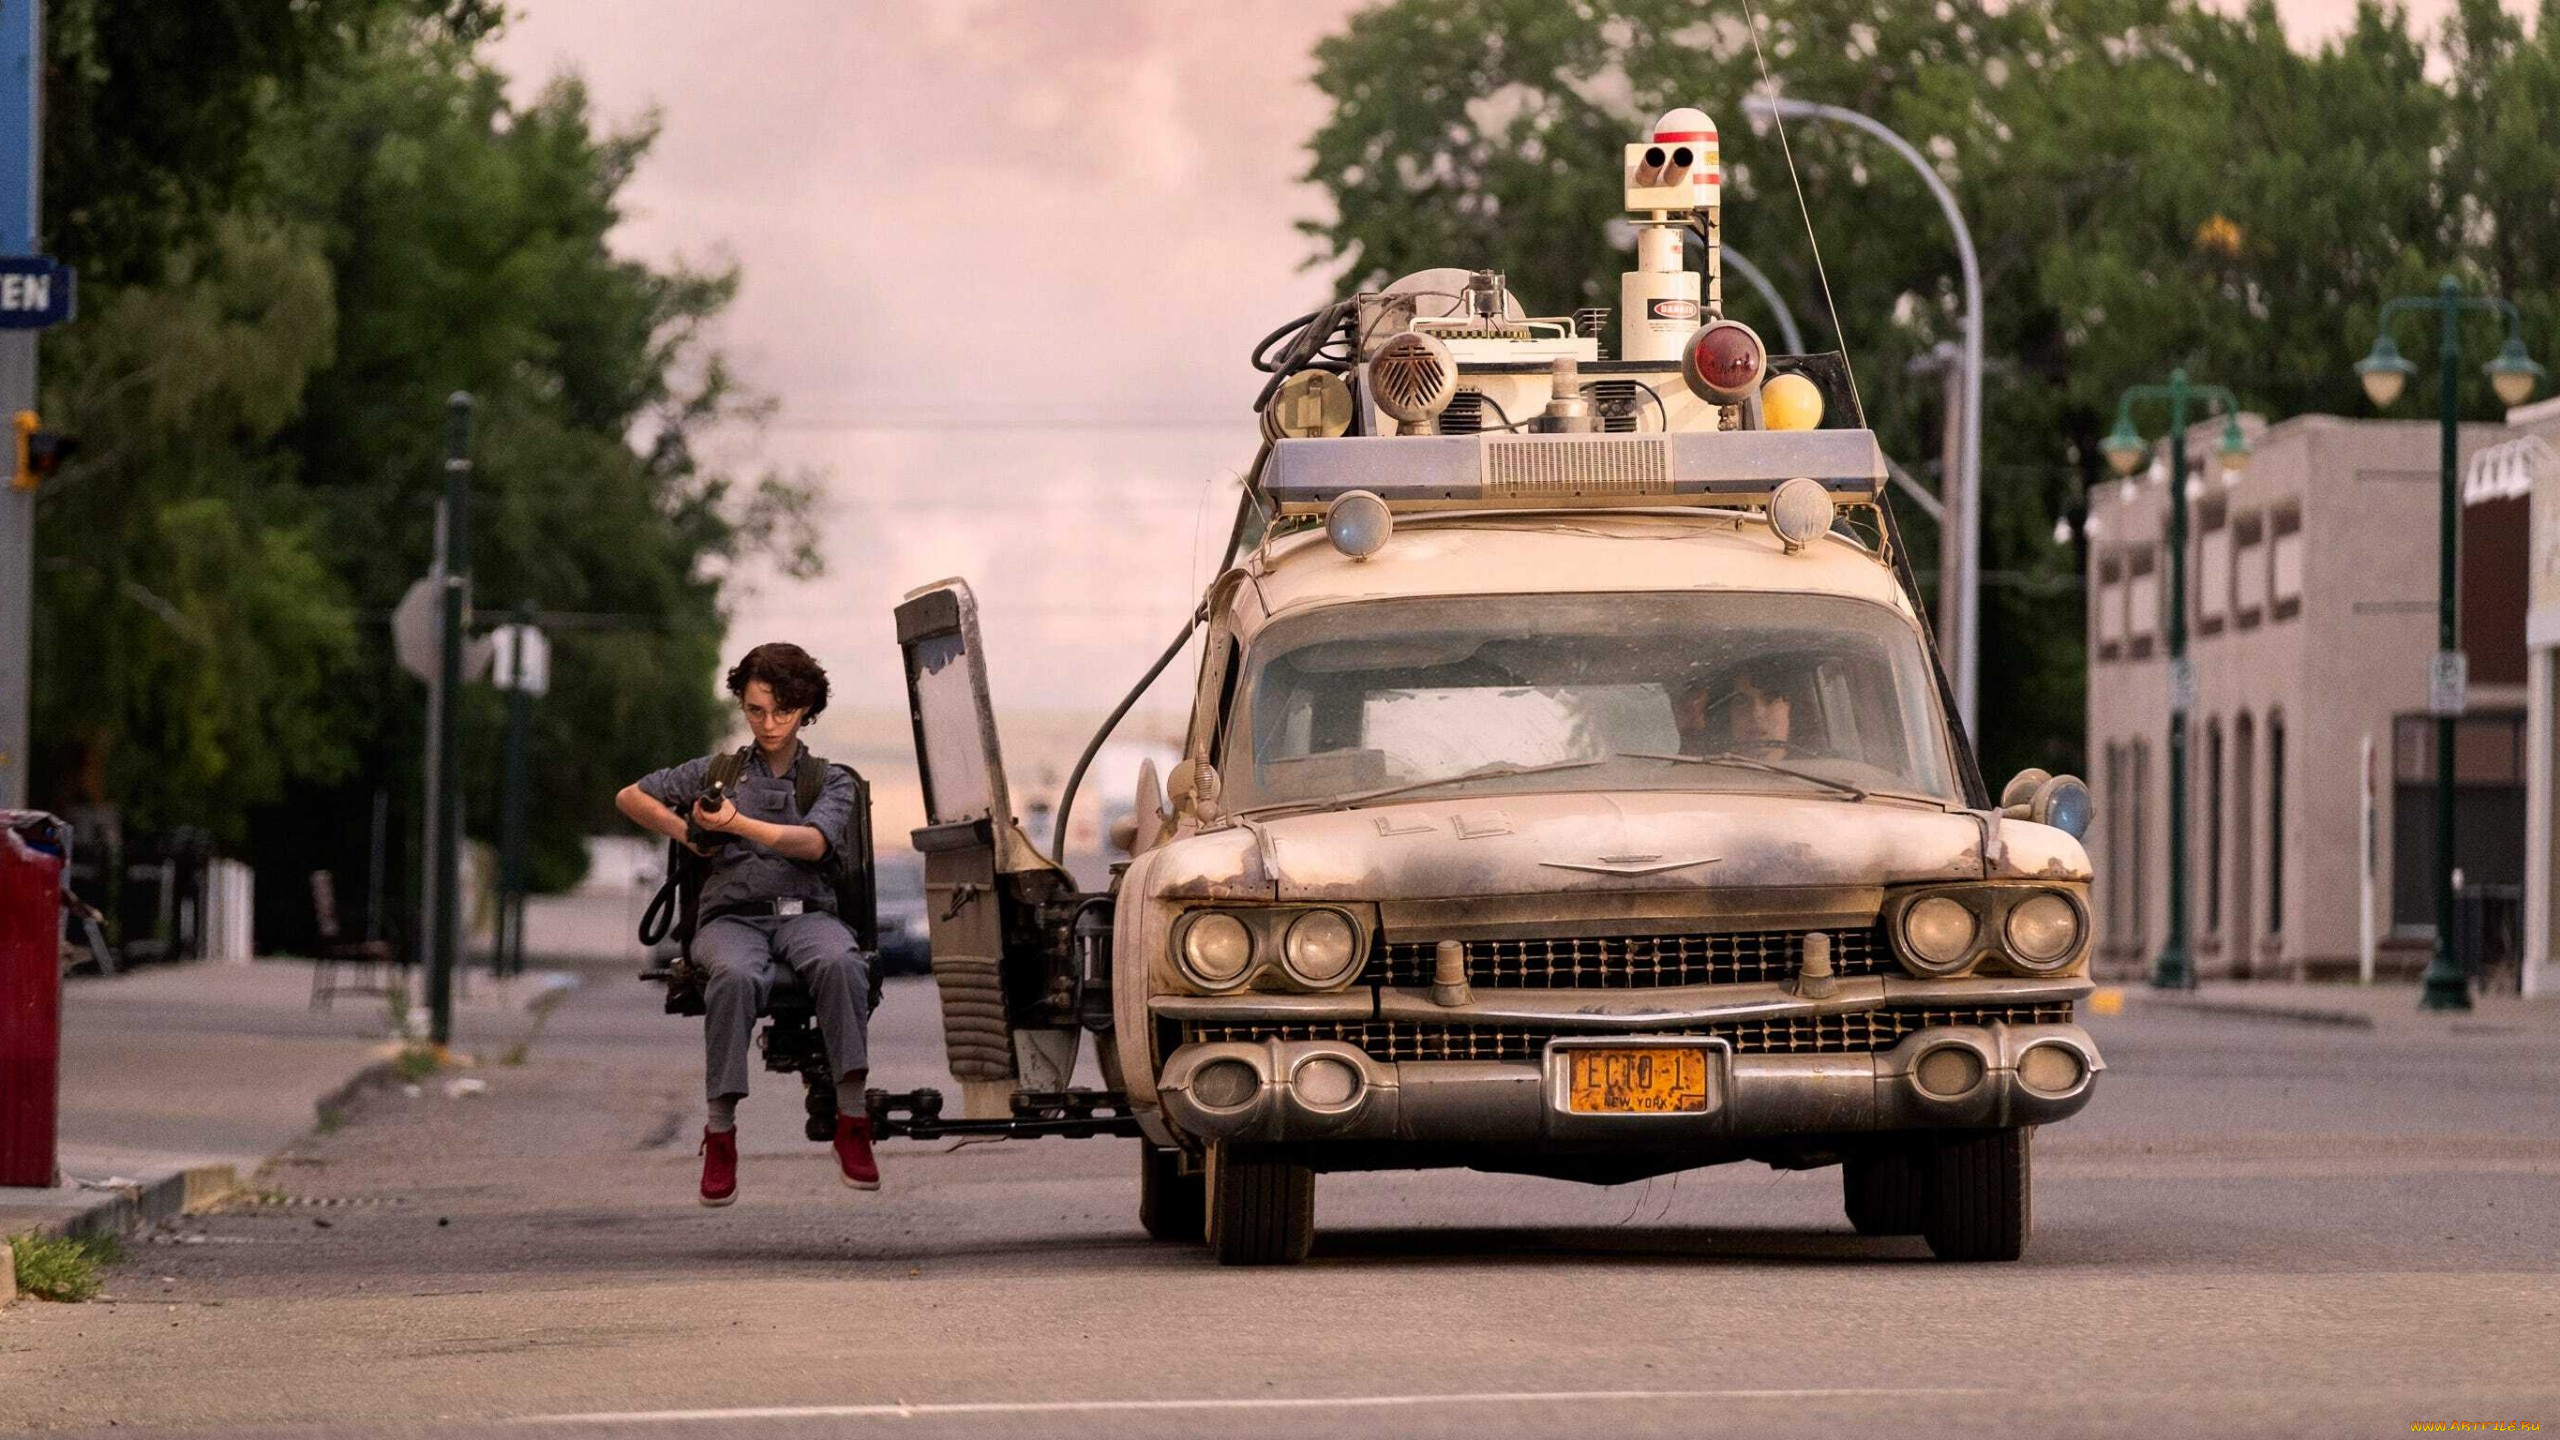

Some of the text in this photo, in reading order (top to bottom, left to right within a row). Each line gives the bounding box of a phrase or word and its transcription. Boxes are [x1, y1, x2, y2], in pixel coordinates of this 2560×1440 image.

[0, 273, 50, 311] EN
[1605, 1096, 1668, 1109] NEW YORK
